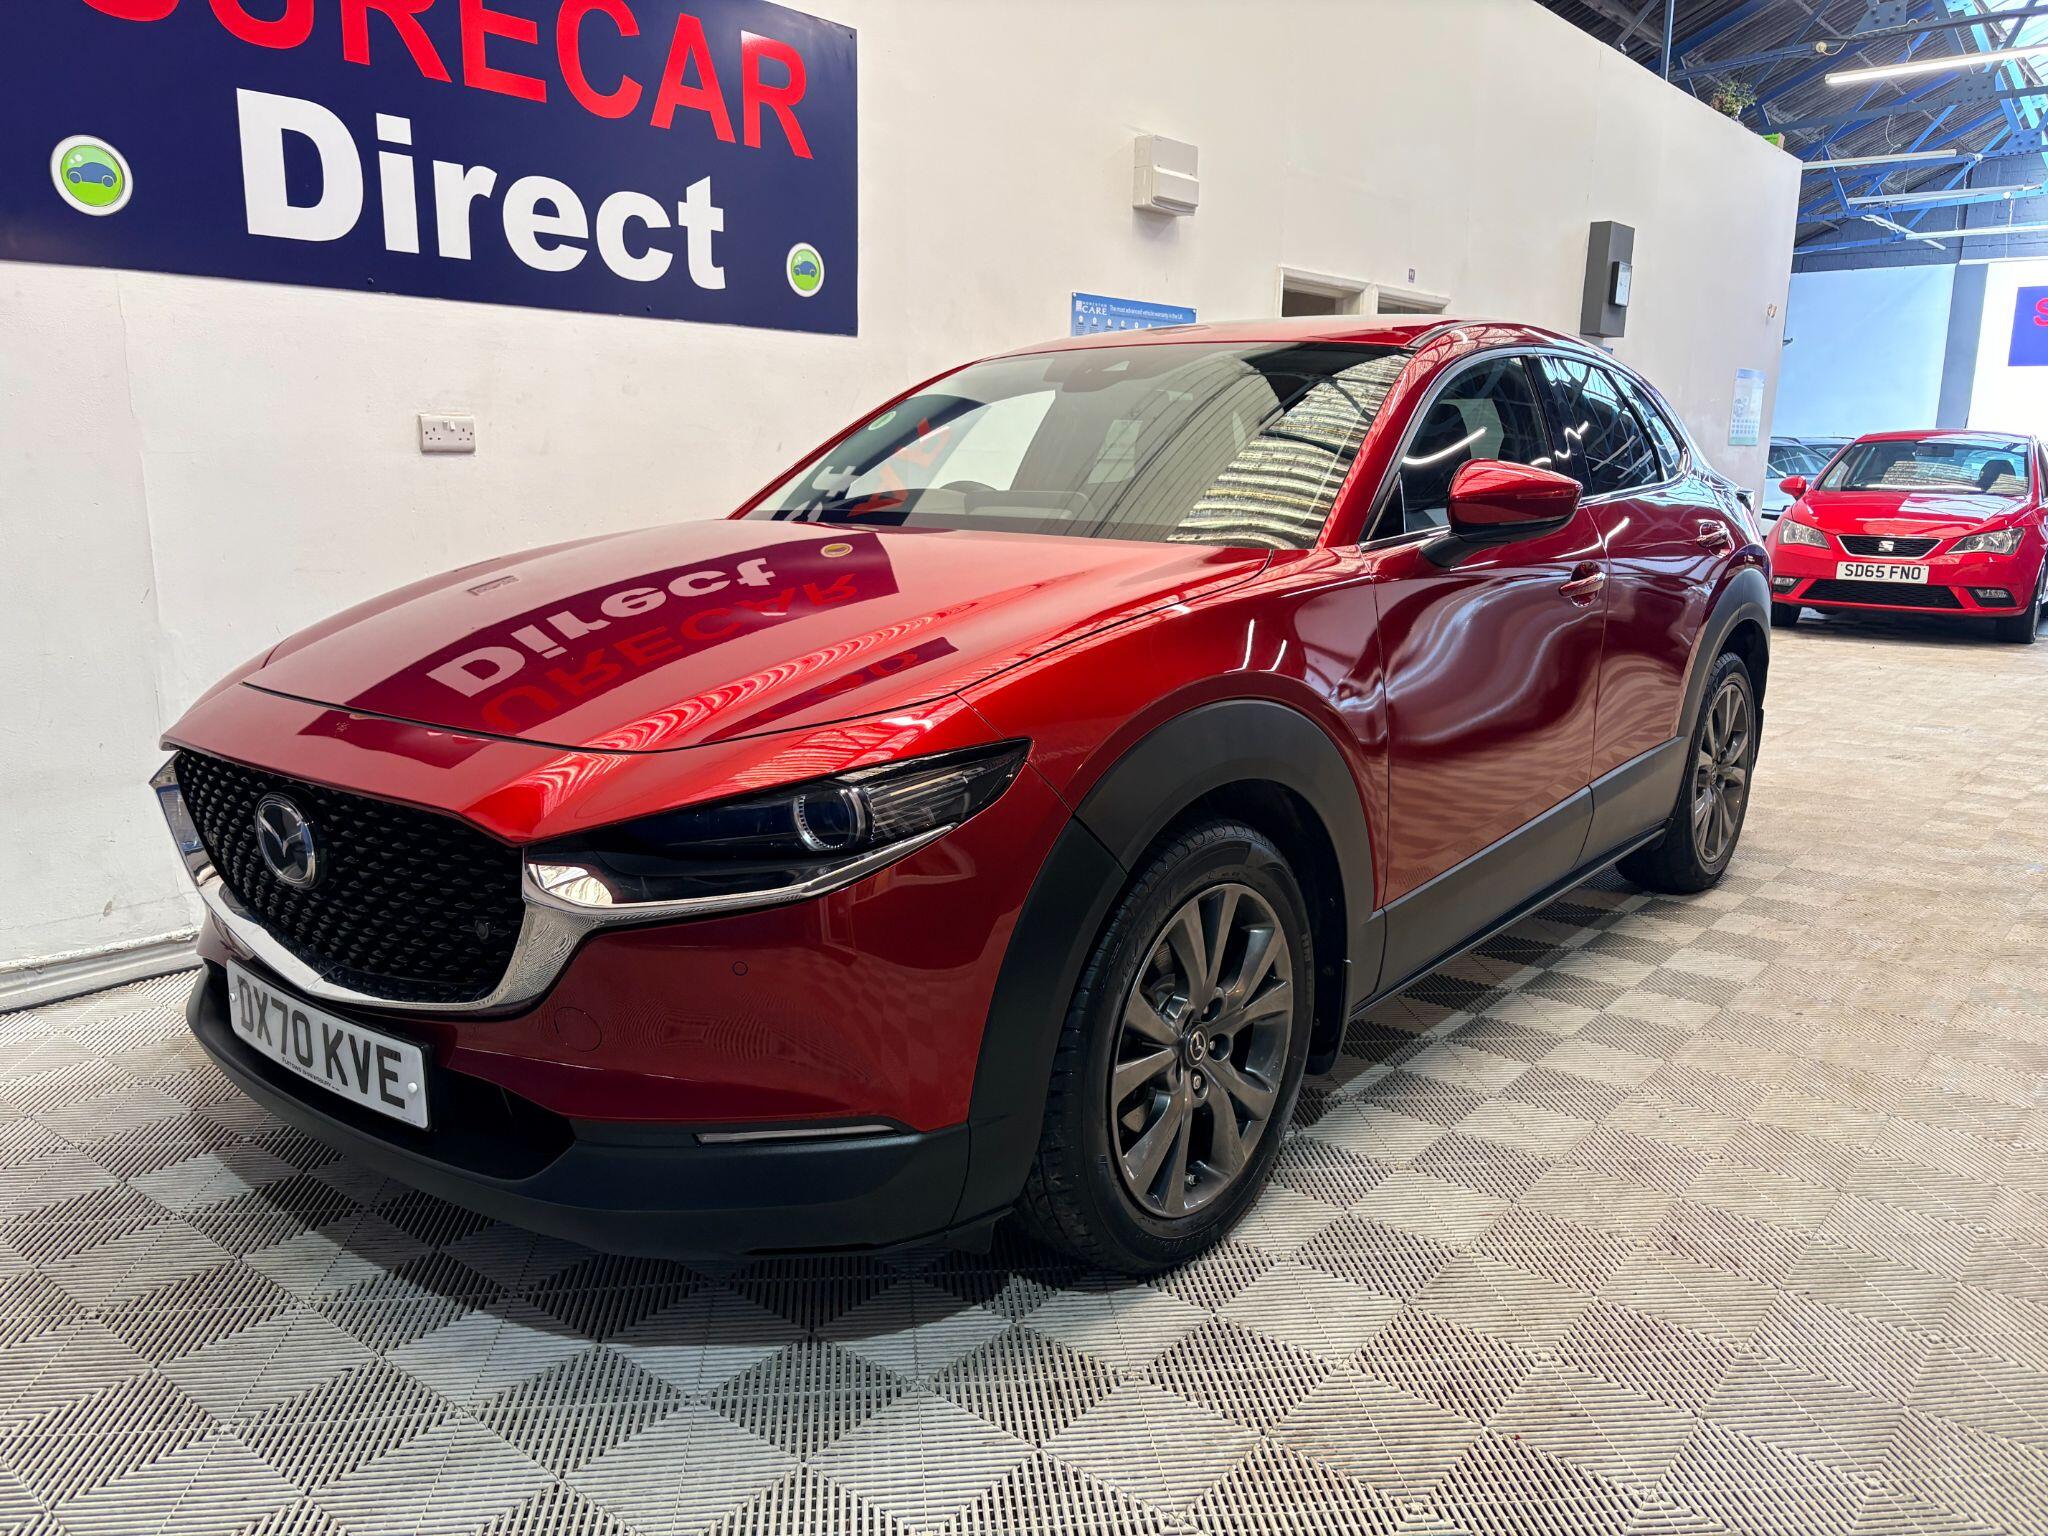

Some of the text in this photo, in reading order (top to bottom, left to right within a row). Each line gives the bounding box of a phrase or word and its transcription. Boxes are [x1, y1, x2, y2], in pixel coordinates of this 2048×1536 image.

[83, 0, 814, 160] ECAR
[236, 88, 726, 290] Direct
[1082, 306, 1108, 316] CARE
[1844, 564, 1921, 580] SD65 FNO
[237, 975, 406, 1110] DX70 KVE
